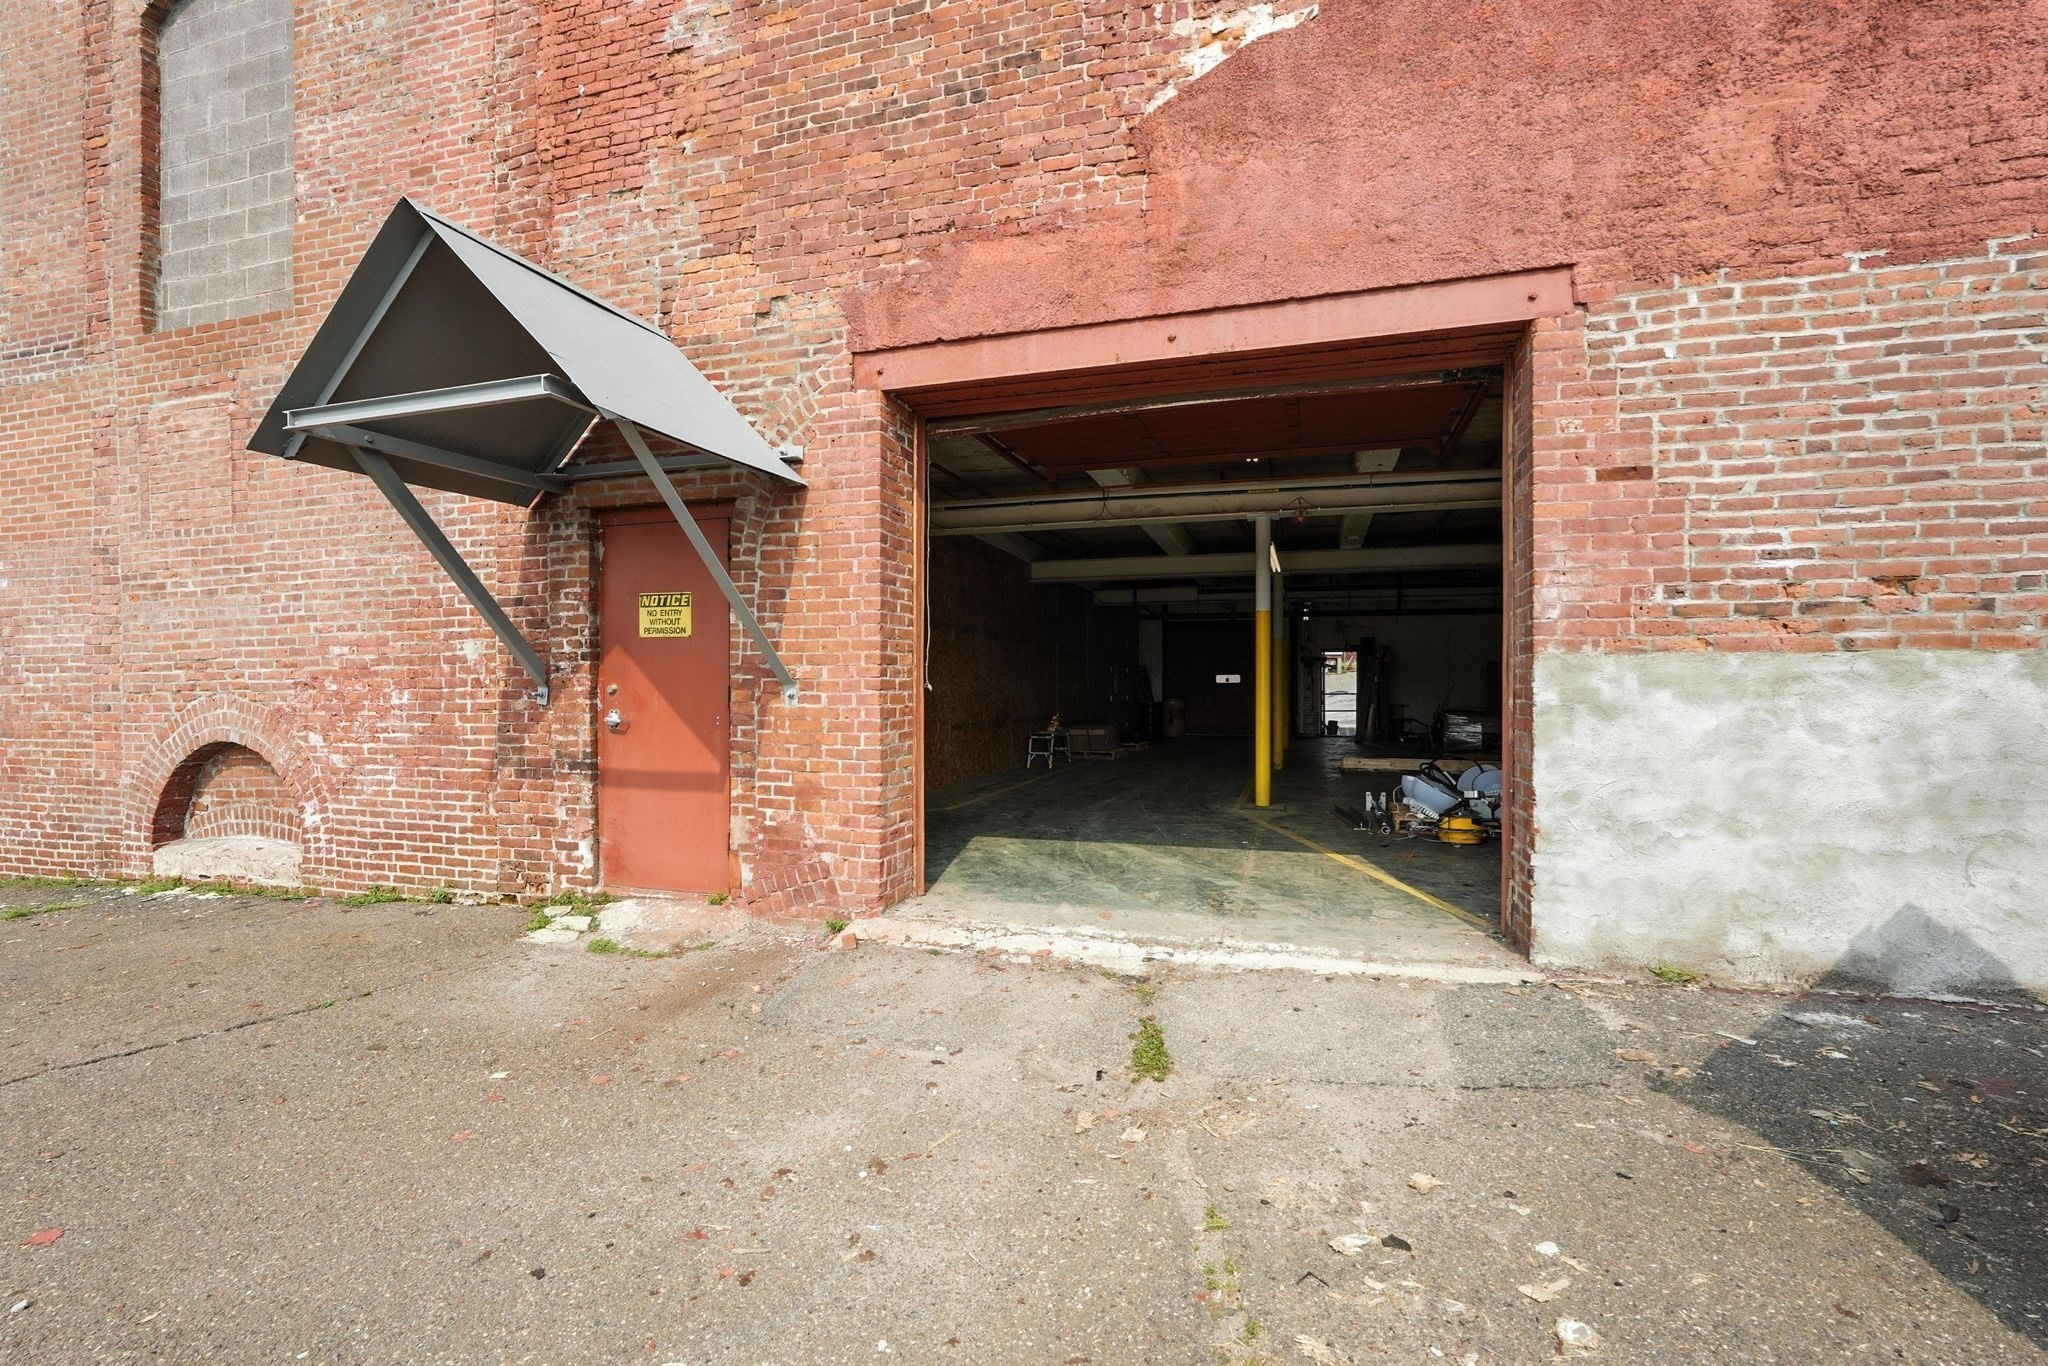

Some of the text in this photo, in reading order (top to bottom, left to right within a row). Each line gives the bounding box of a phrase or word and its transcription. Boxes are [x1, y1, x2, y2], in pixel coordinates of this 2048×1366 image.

[641, 595, 689, 606] NOTICE
[647, 609, 682, 617] NO ENTRY
